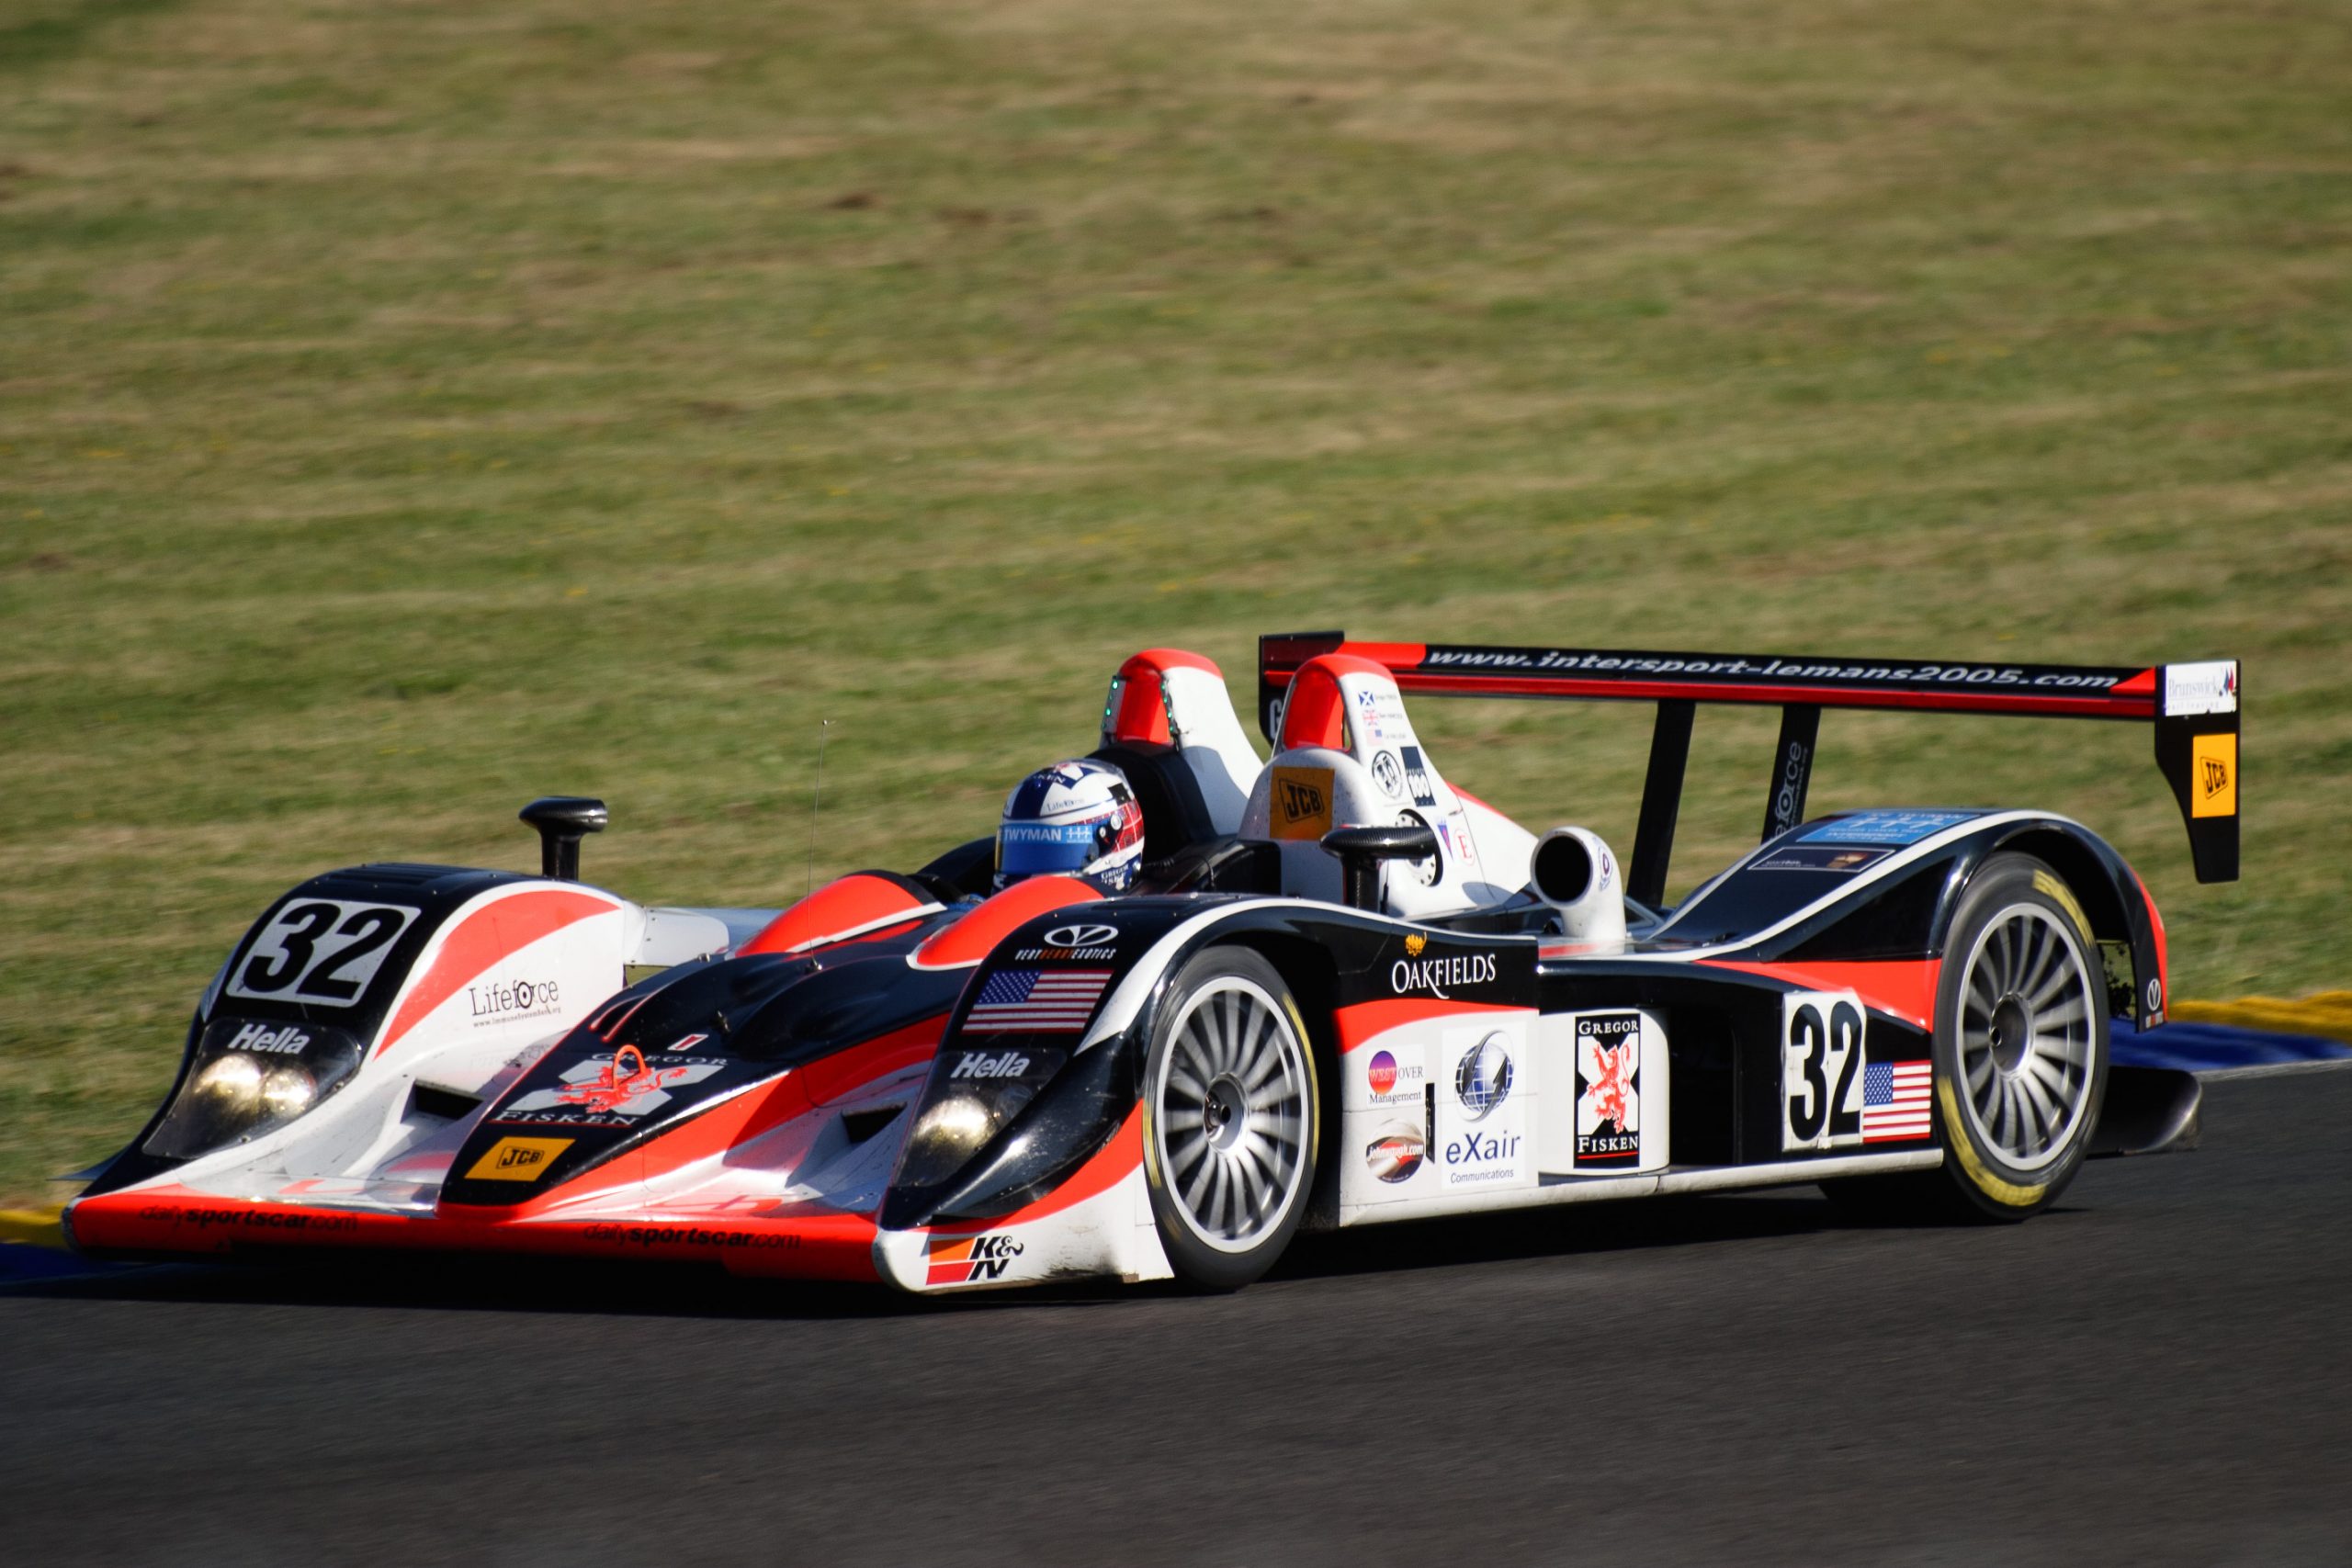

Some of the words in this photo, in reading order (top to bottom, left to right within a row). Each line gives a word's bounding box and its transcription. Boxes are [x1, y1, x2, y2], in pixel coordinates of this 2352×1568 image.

[1428, 650, 2119, 688] www.intersport-lemans2005.com
[2205, 761, 2227, 794] JCB
[1286, 783, 1322, 819] JCB
[1004, 829, 1061, 841] TWYMAN
[243, 903, 406, 999] 32
[1391, 953, 1497, 999] OAKFIELDS
[469, 979, 559, 1017] Lifeforce
[228, 1023, 311, 1055] Hella
[1578, 1020, 1639, 1035] GREGOR
[950, 1052, 1031, 1078] Hella
[1790, 1000, 1862, 1141] 32
[1369, 1091, 1422, 1105] Management
[492, 1111, 640, 1126] FISKEN
[500, 1148, 542, 1166] JCB
[1445, 1130, 1522, 1165] eXair
[1577, 1135, 1639, 1153] FISKEN
[1450, 1168, 1515, 1184] Communications
[139, 1205, 358, 1231] dailysportscar.com
[582, 1224, 802, 1249] dailysportscar.com
